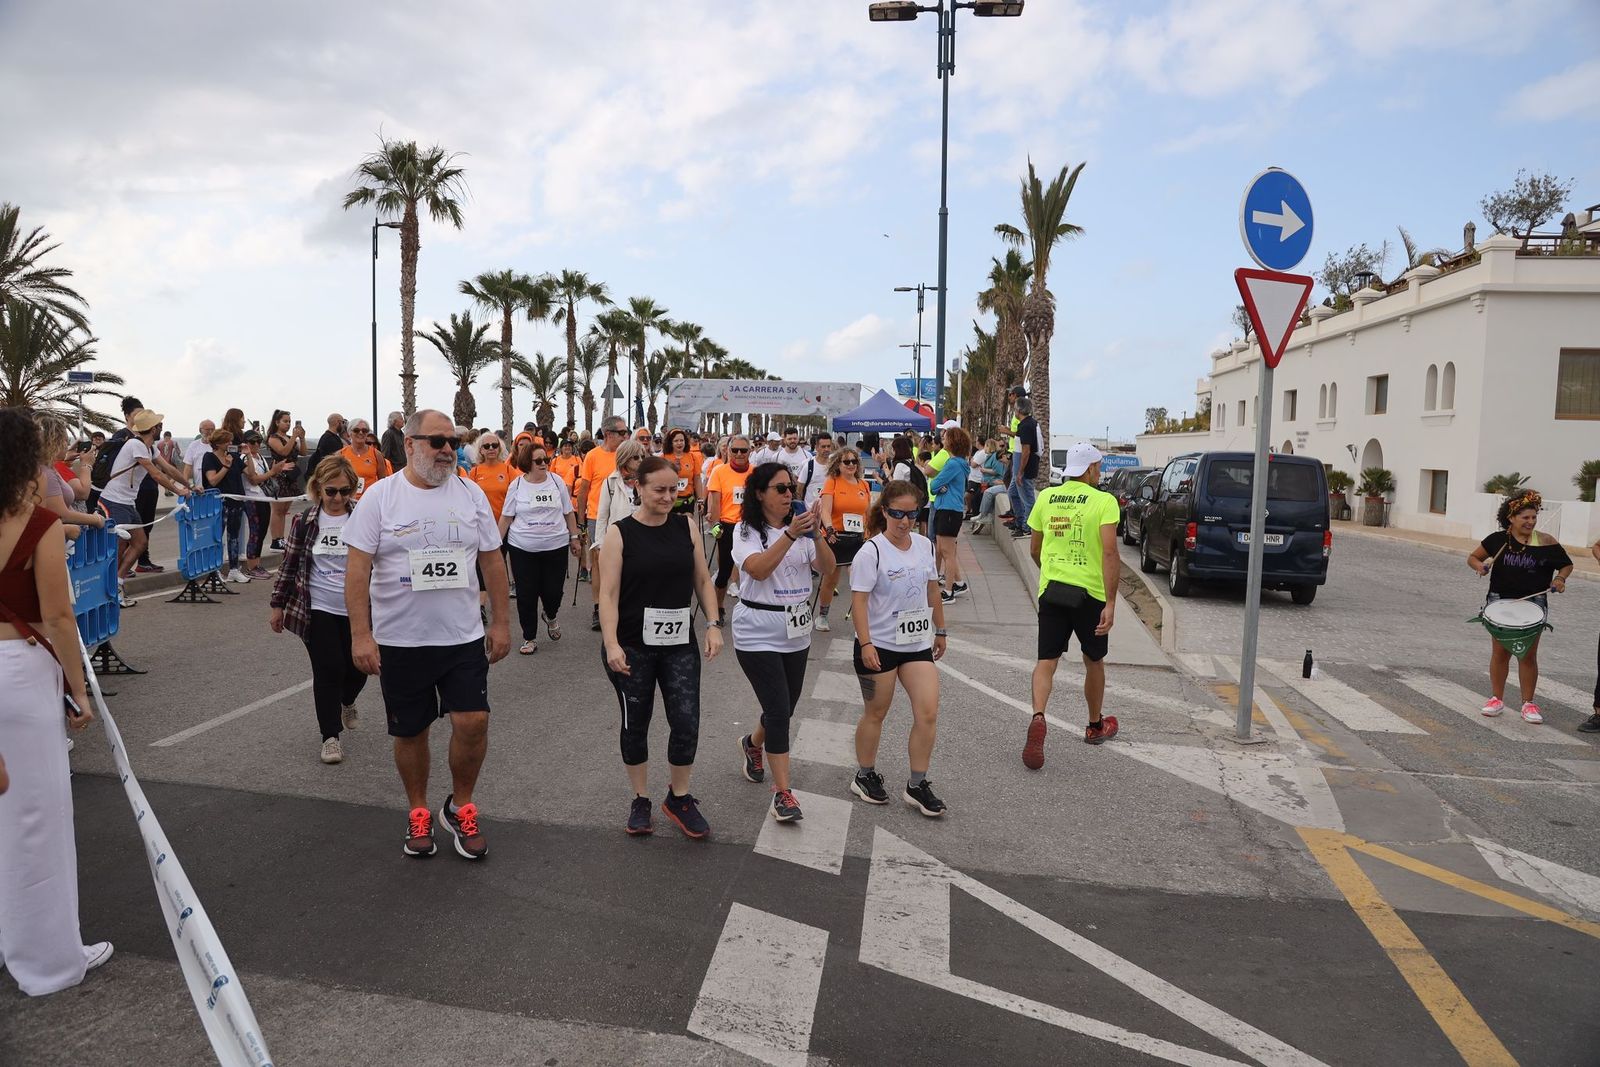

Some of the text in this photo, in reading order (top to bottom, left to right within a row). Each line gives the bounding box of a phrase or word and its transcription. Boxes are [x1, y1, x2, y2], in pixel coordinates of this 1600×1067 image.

[729, 385, 798, 394] 3A CARRERA 5K
[1048, 493, 1089, 504] CARRERA 5K
[847, 519, 861, 527] 714
[1265, 535, 1281, 544] HNR
[422, 561, 458, 577] 452
[653, 621, 683, 635] 737
[899, 618, 929, 634] 1030
